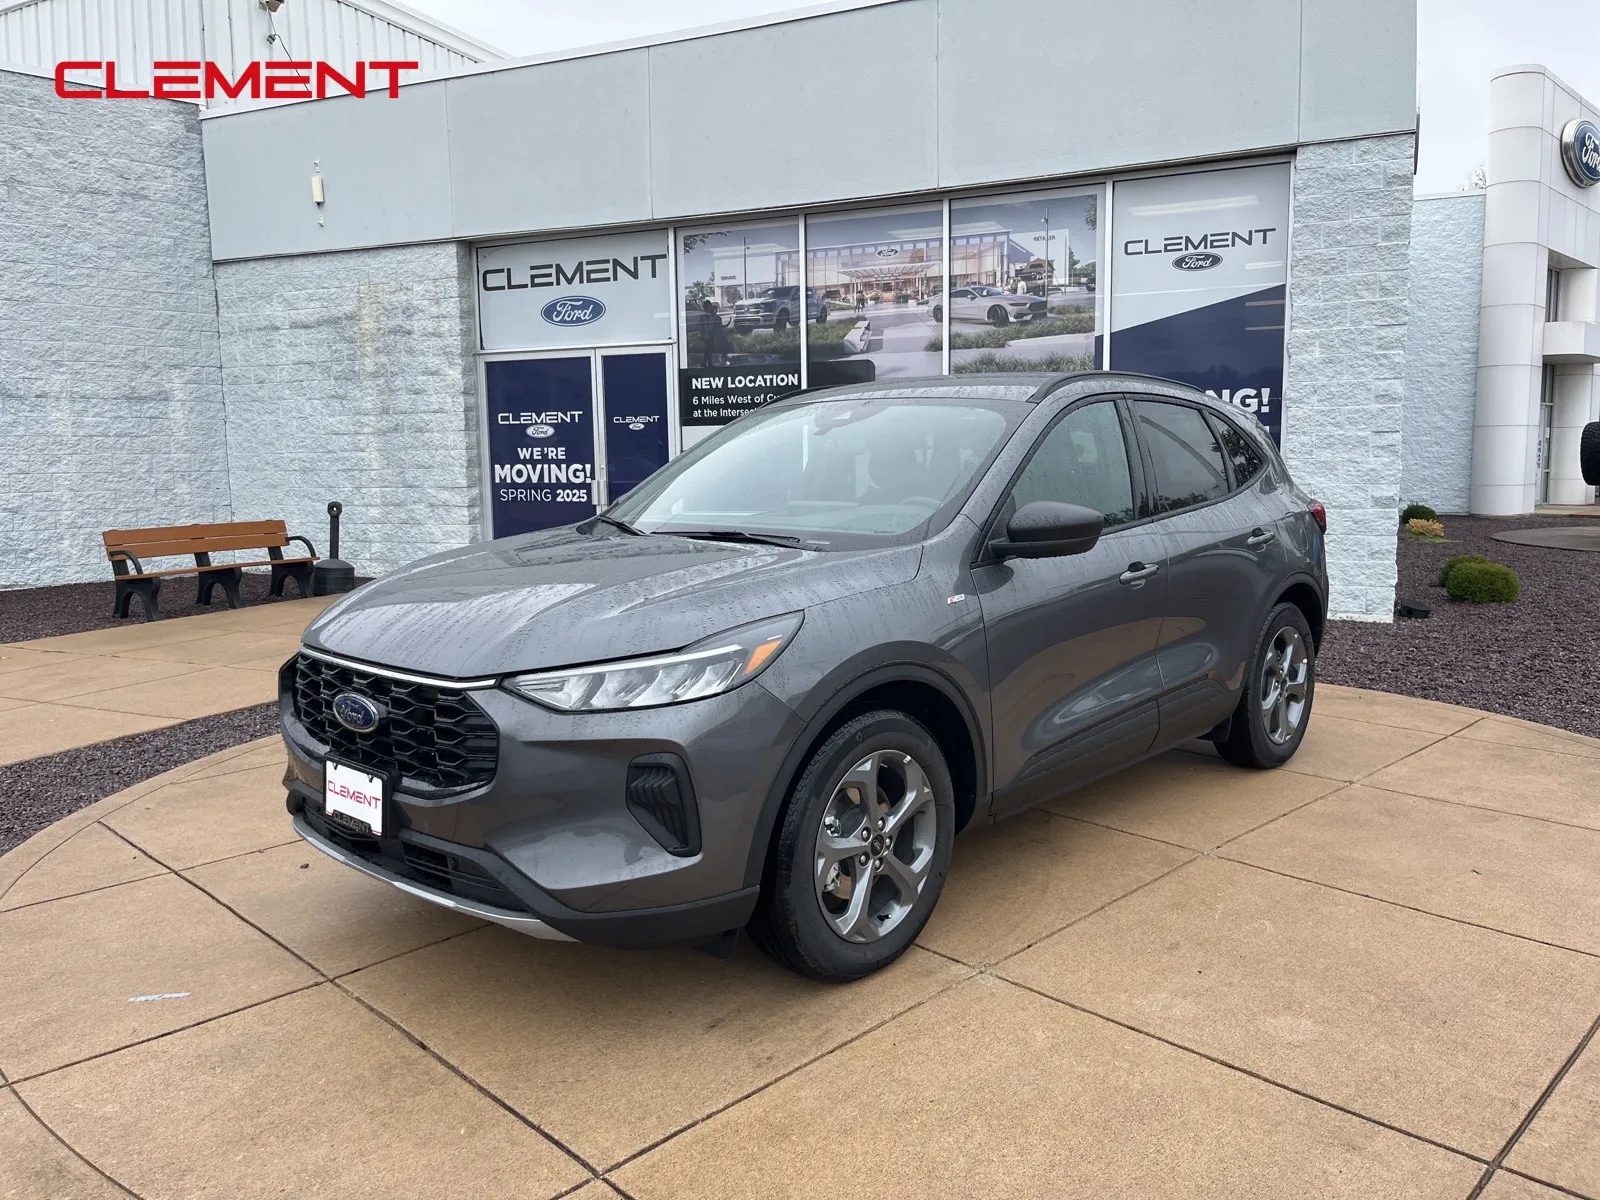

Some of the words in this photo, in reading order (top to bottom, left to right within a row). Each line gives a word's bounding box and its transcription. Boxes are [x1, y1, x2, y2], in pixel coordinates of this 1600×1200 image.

[1124, 228, 1276, 256] CLEMENT
[1182, 255, 1212, 269] Ford
[482, 254, 667, 291] CLEMENT
[552, 300, 594, 322] Ford
[692, 376, 724, 389] NEW
[727, 373, 799, 388] LOCATION
[692, 396, 699, 405] 6
[701, 395, 725, 405] Miles
[727, 394, 752, 404] West
[754, 393, 765, 403] of
[497, 411, 583, 424] CLEMENT
[693, 409, 701, 418] at
[704, 408, 718, 417] the
[531, 426, 549, 436] Ford
[494, 464, 592, 484] MOVING!
[500, 488, 551, 502] SPRING
[556, 489, 588, 502] 2025
[340, 700, 365, 725] Ford
[327, 780, 382, 809] CLEMENT
